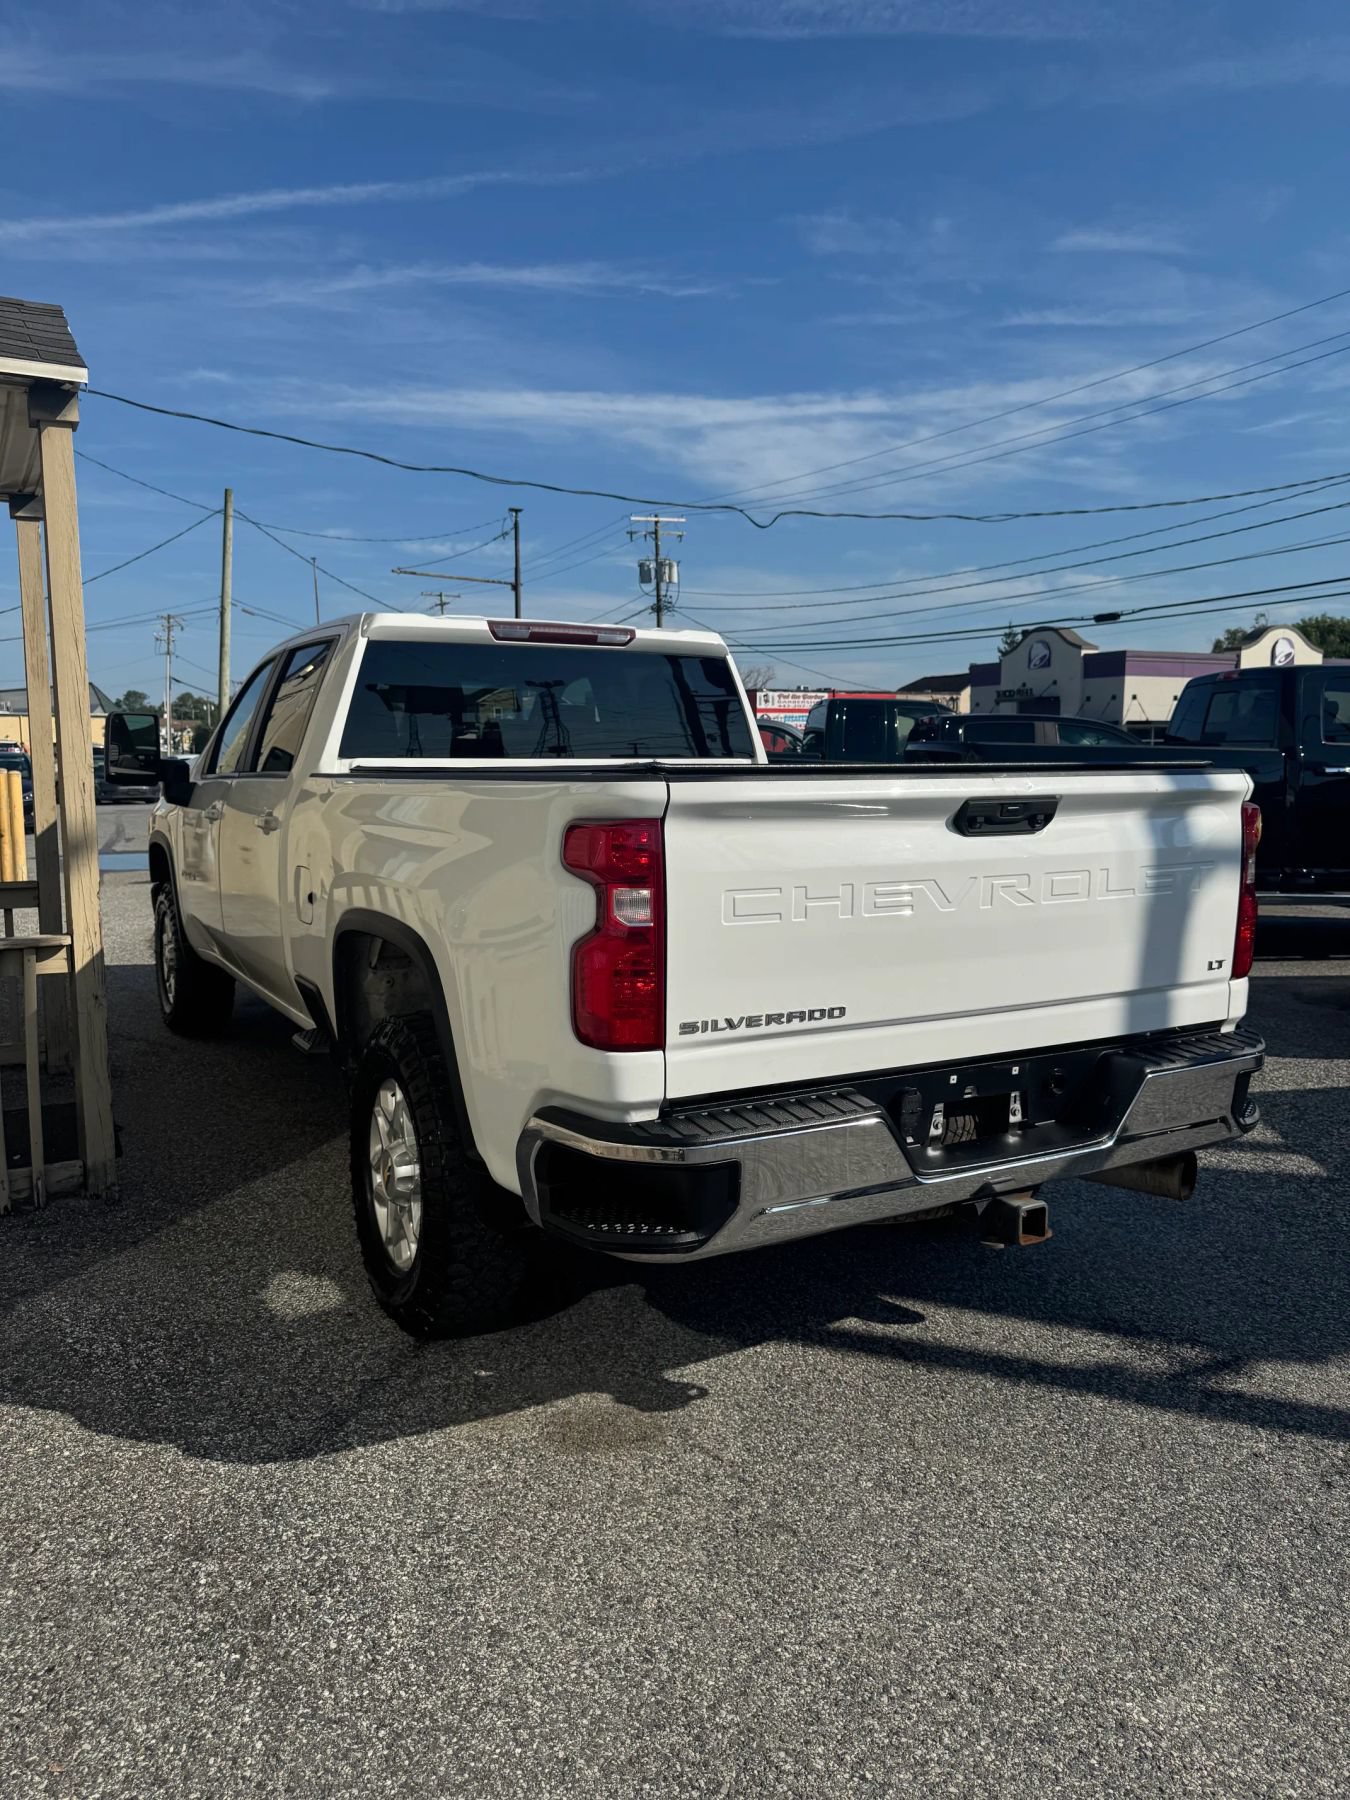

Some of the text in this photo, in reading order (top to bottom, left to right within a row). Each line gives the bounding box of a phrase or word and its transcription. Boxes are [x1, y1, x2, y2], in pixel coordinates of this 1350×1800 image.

[721, 860, 1215, 926] CHEVROLET
[1207, 960, 1226, 971] LT
[679, 1006, 847, 1036] SILVERADO
